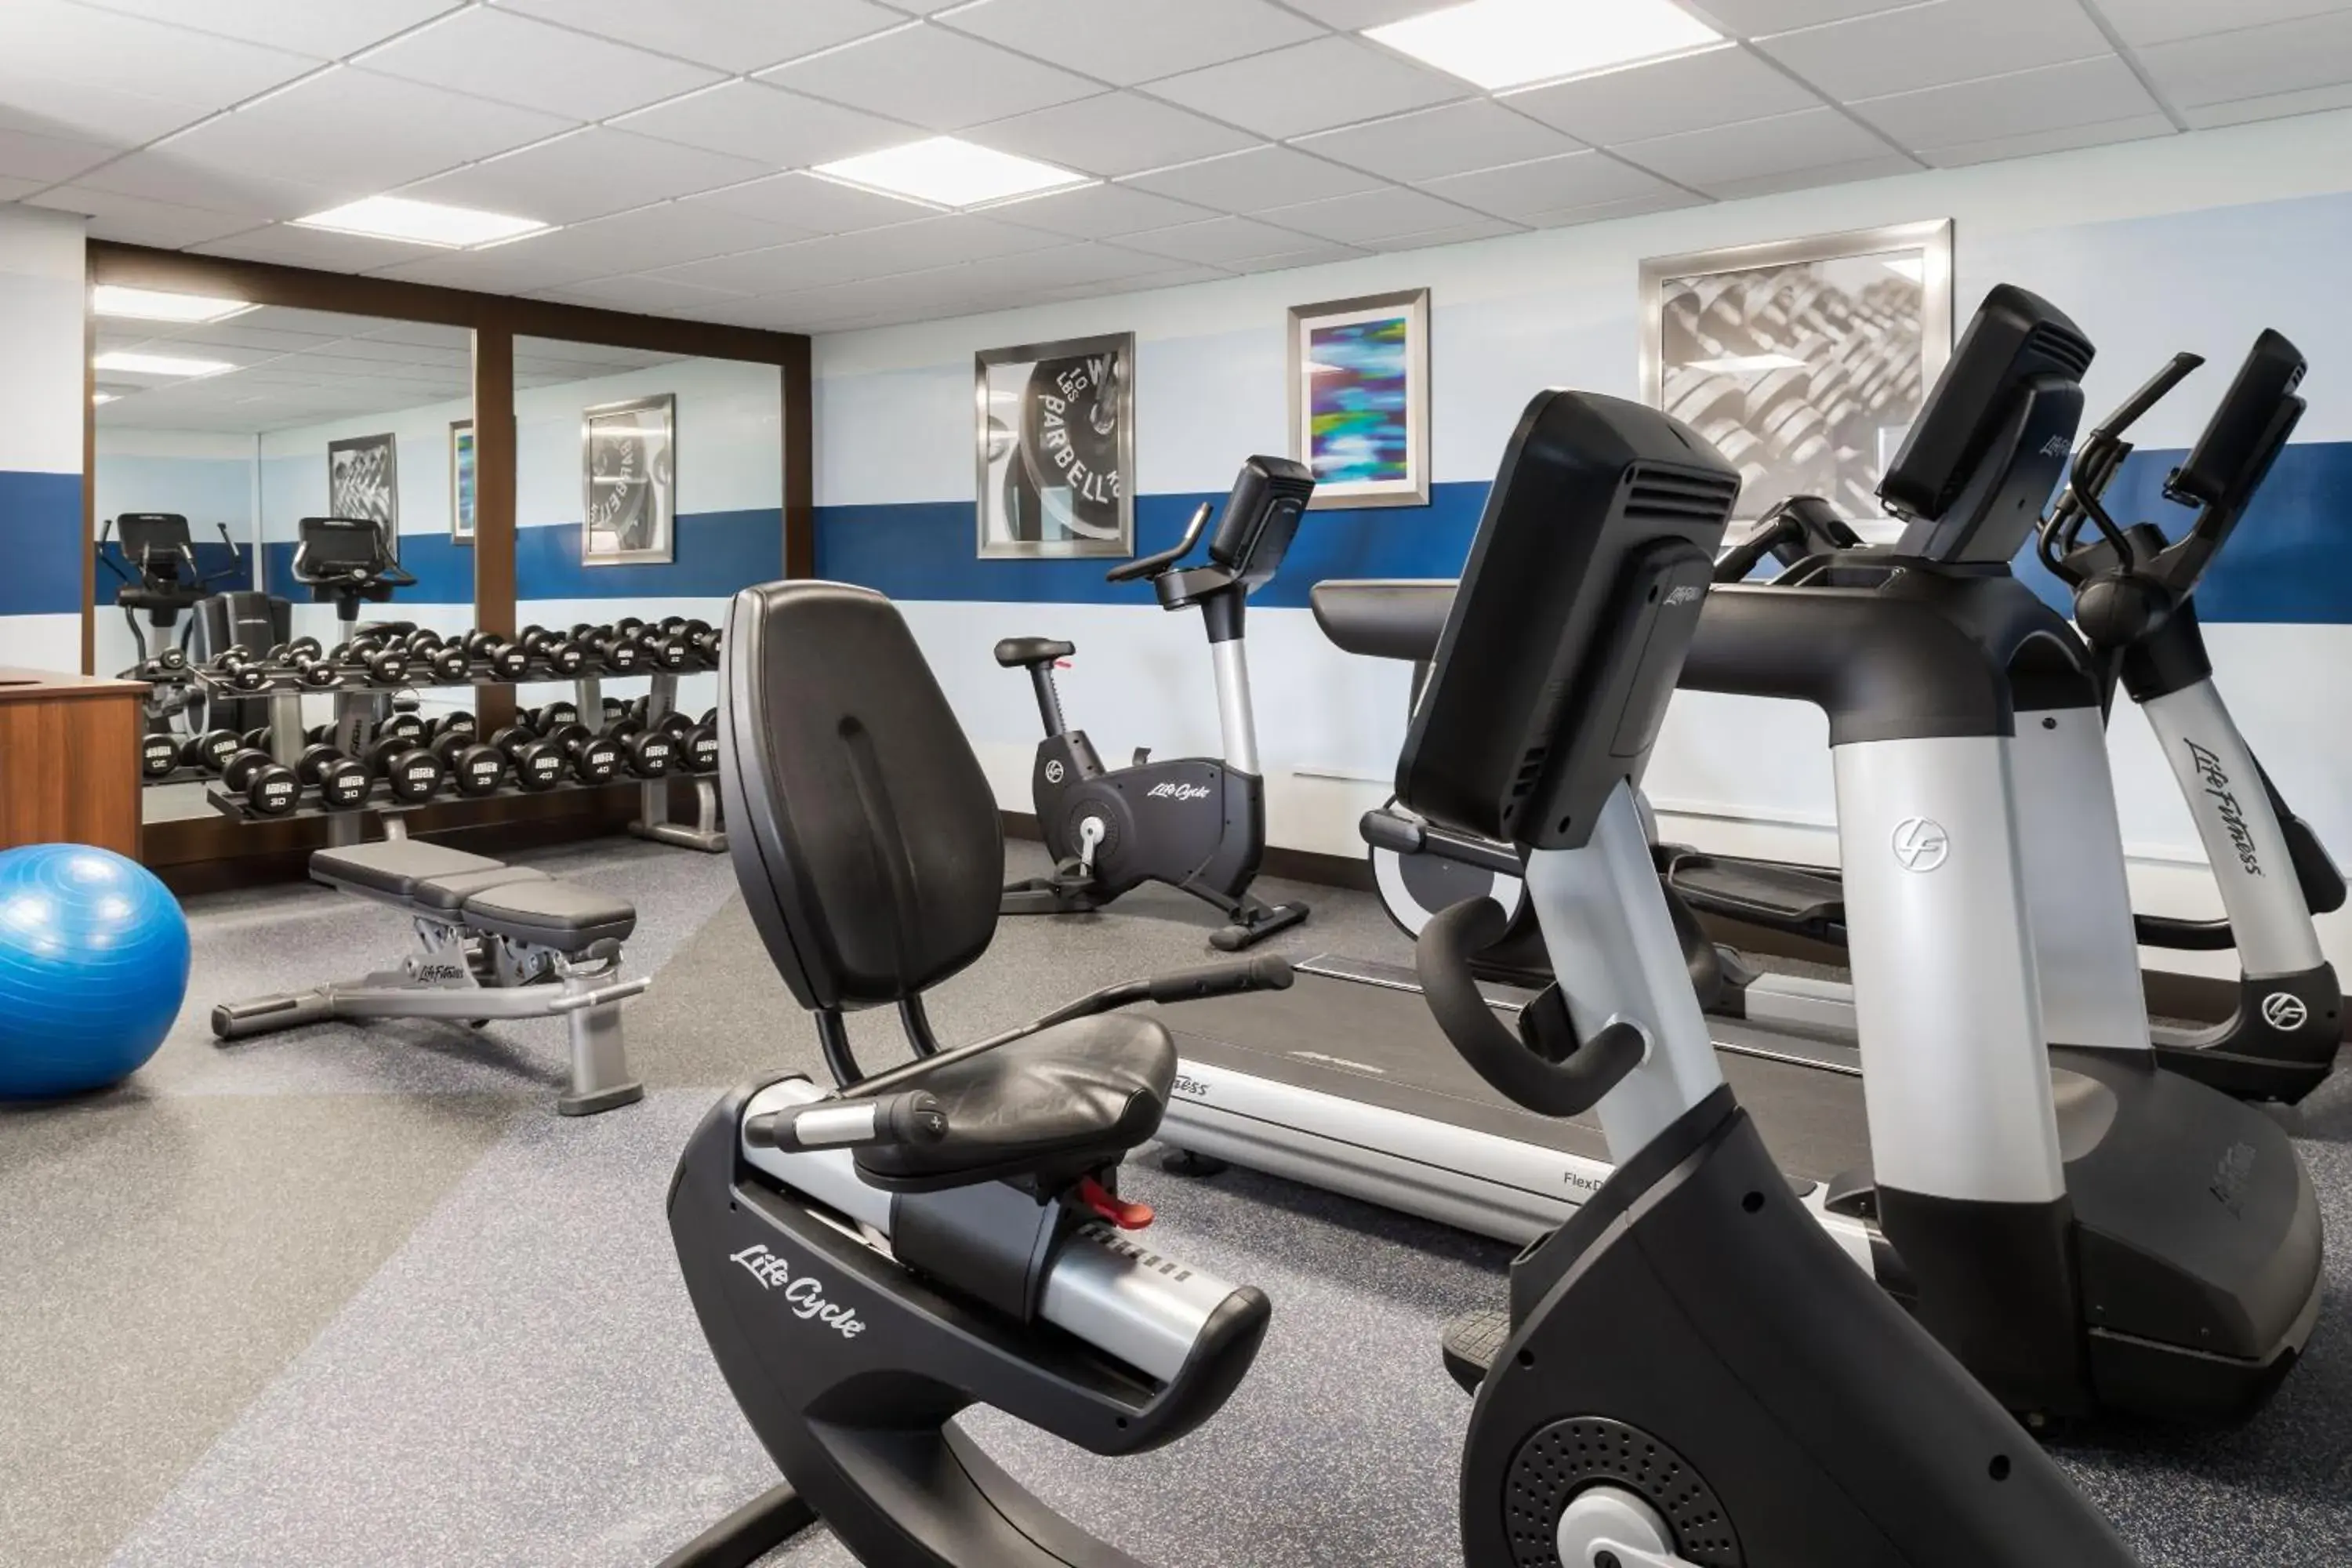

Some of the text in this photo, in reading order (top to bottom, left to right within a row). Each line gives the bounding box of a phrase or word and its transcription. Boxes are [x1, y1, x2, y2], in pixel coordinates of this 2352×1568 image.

[1056, 371, 1080, 402] LBS
[1041, 394, 1109, 503] BARBELL
[2183, 737, 2262, 875] Life Fitness
[1564, 1172, 1604, 1191] FlexD
[730, 1244, 866, 1338] Life Cycle
